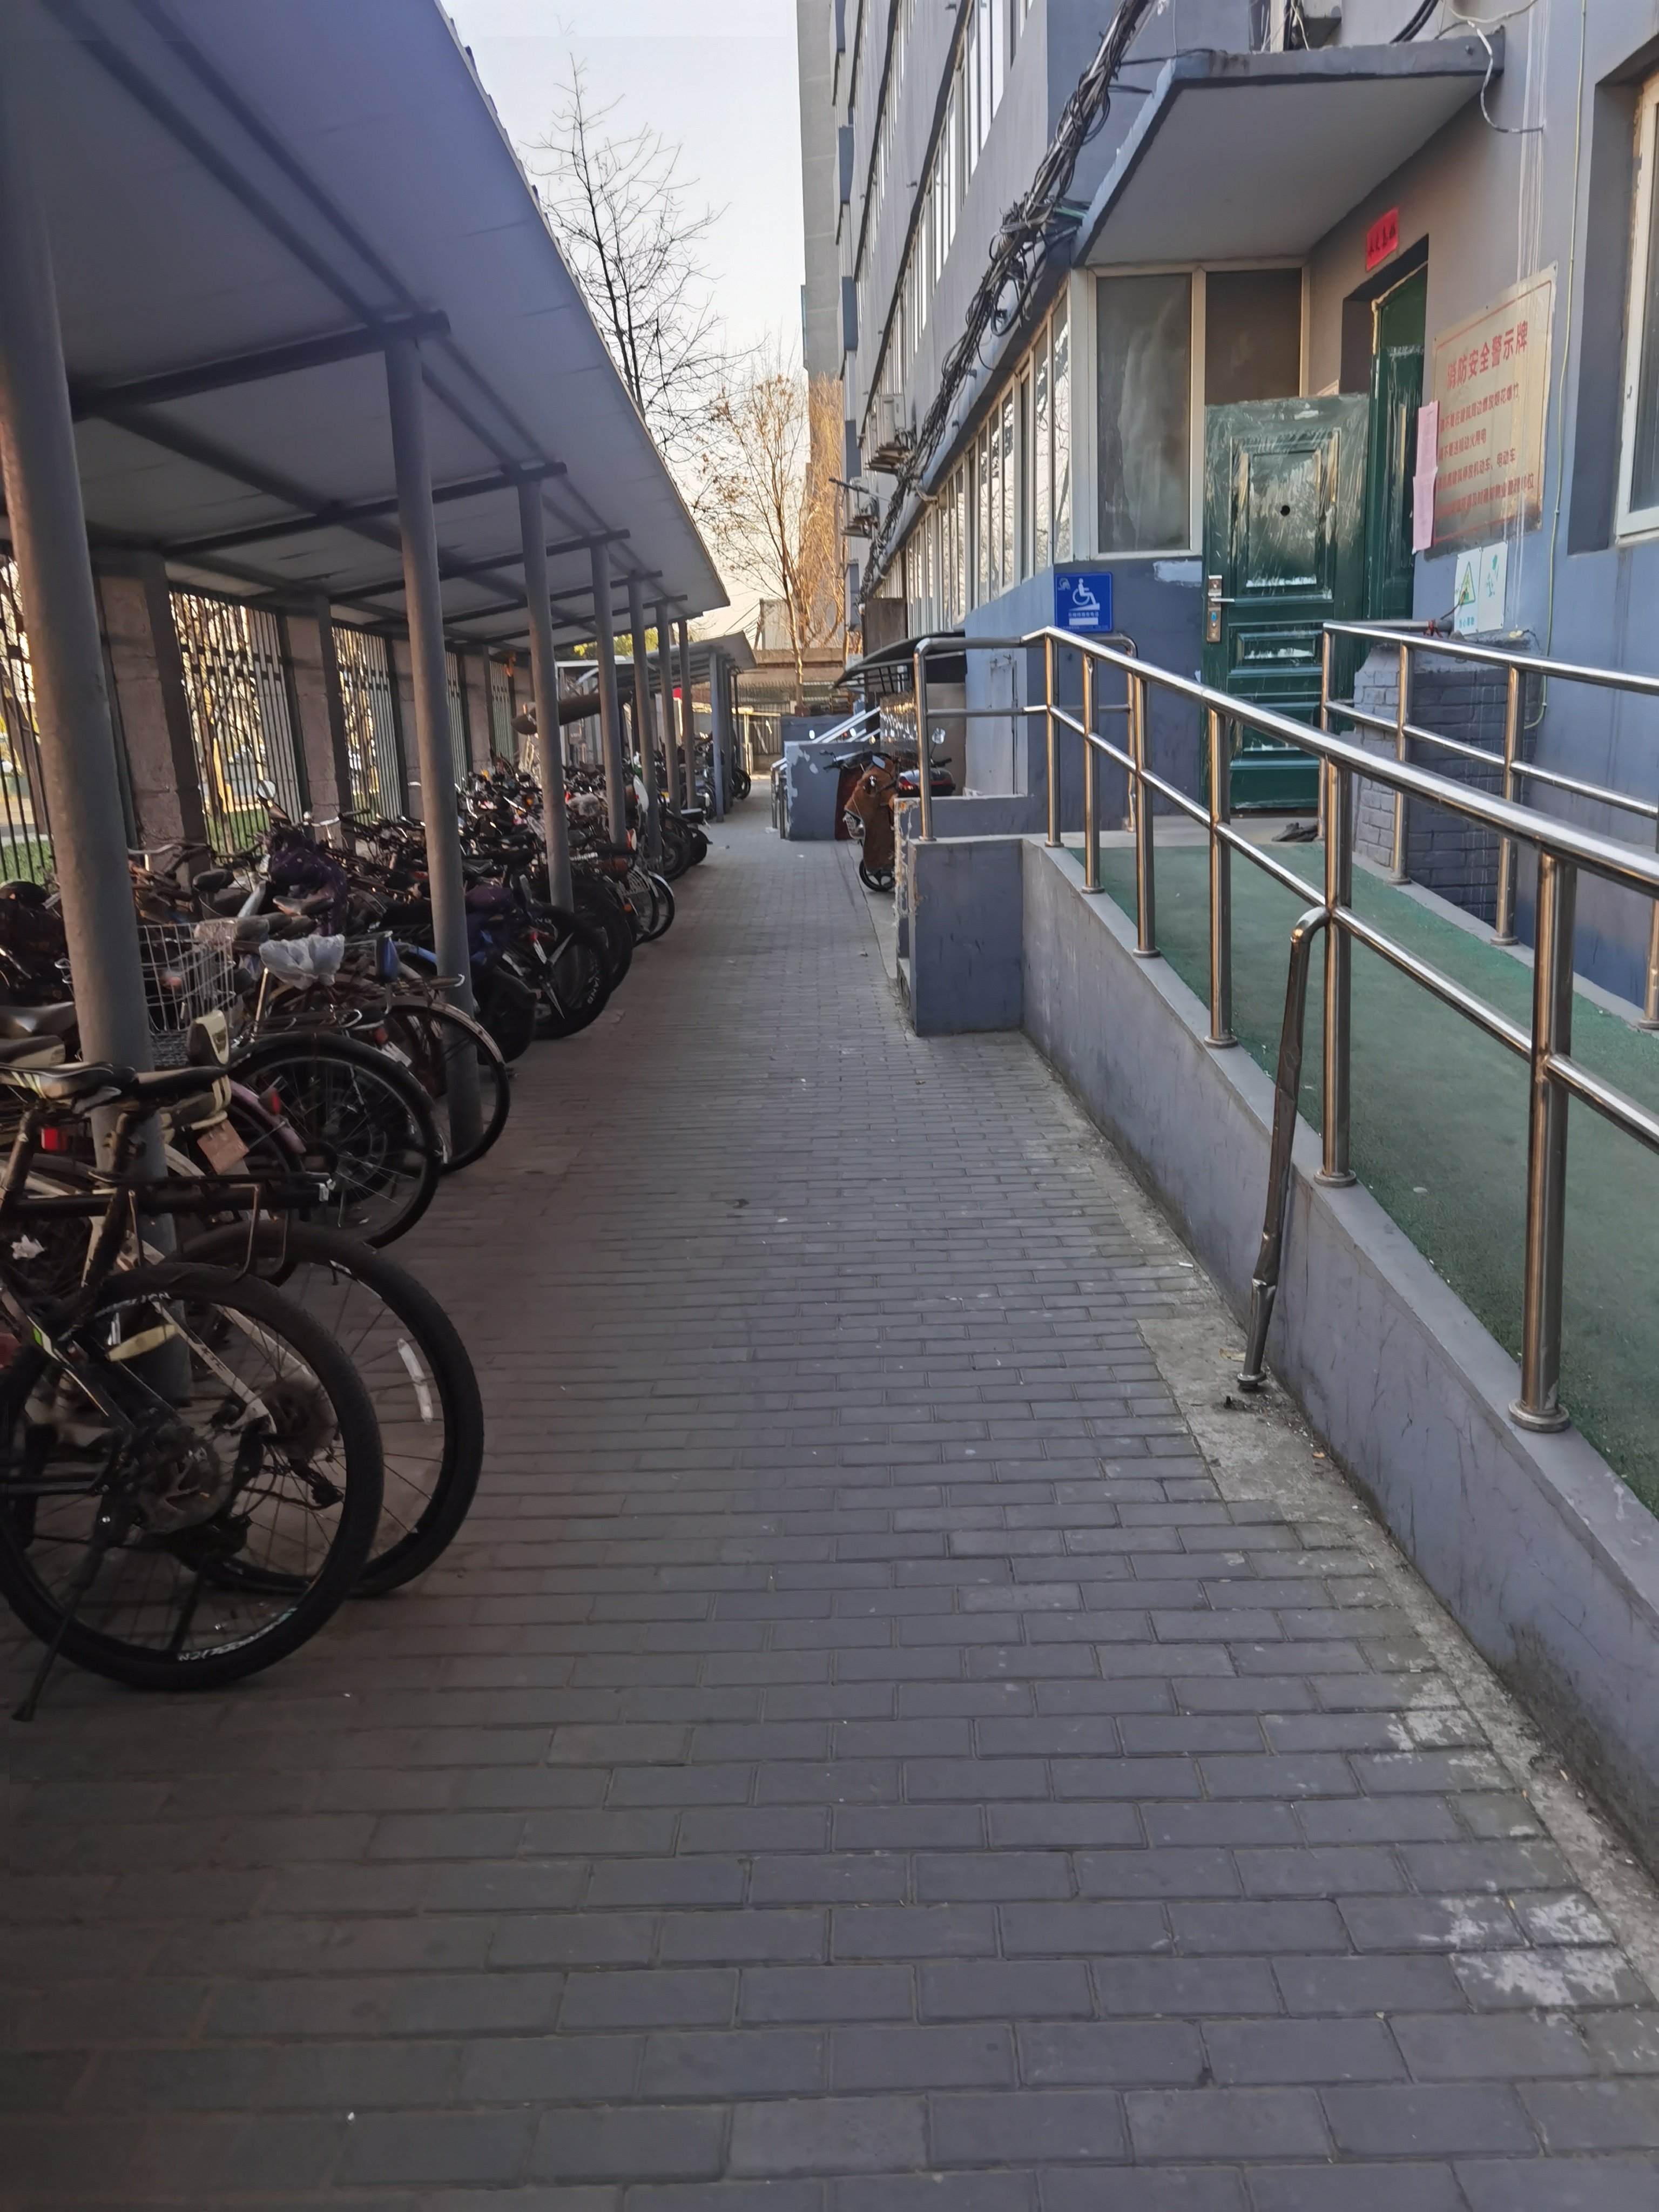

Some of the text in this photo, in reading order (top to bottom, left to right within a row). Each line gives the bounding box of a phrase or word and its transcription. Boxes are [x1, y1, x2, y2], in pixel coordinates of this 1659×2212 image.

[1447, 320, 1528, 391] 消防安全警示牌
